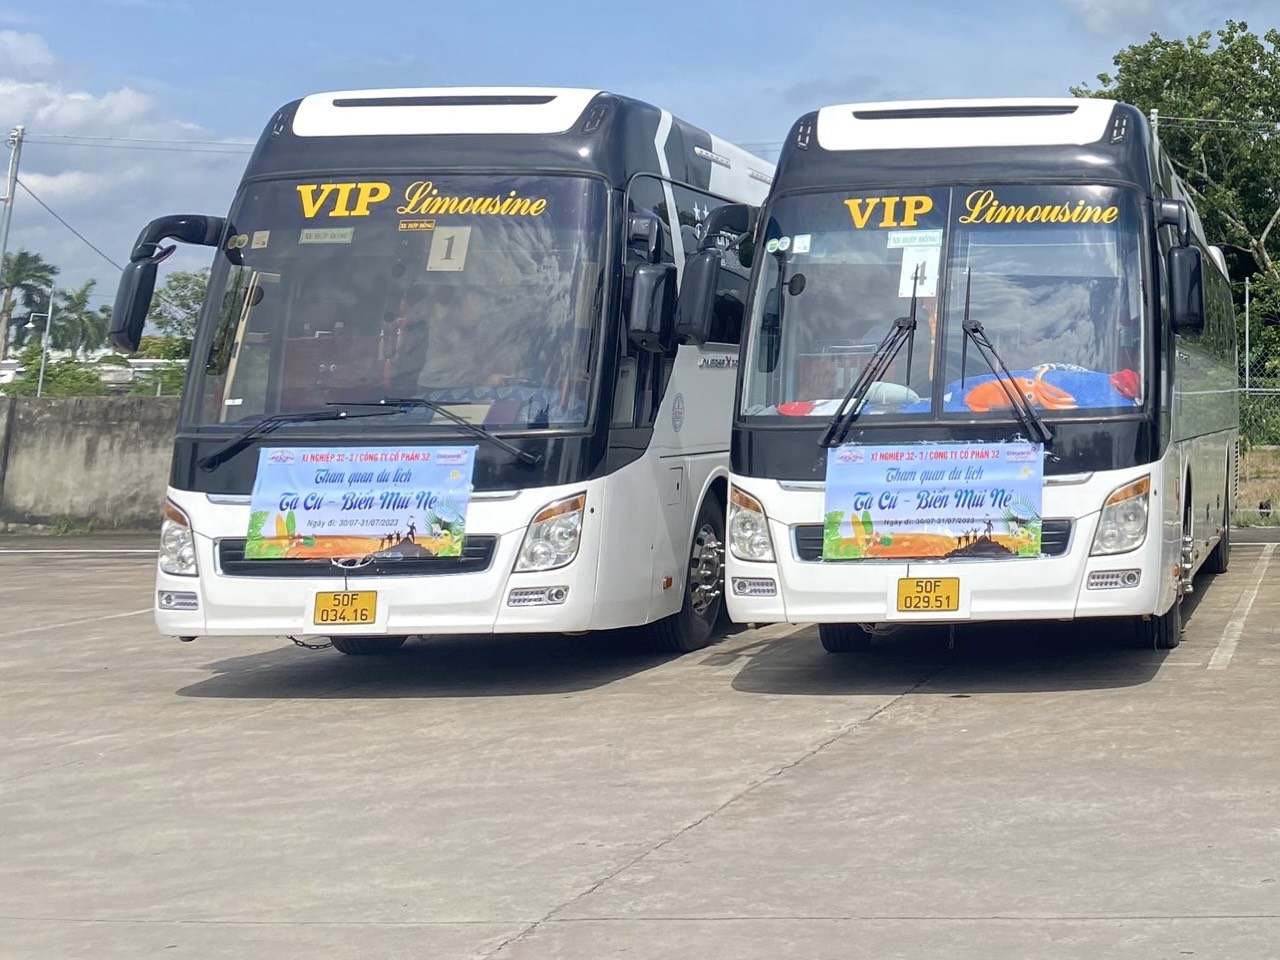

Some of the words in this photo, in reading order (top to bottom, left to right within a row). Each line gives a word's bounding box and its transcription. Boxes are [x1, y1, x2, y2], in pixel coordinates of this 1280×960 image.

[297, 182, 390, 218] VIP
[397, 181, 546, 216] Limousine
[844, 196, 933, 228] VIP
[959, 190, 1118, 224] Limousine
[441, 235, 456, 261] 1
[910, 261, 928, 286] 4
[380, 453, 388, 461] TY
[421, 453, 430, 461] 32
[950, 450, 957, 460] TY
[992, 450, 1000, 459] 32
[315, 469, 345, 484] Tham
[348, 472, 374, 487] quan
[376, 469, 390, 483] du
[393, 468, 412, 486] lịch
[886, 467, 916, 482] Tham
[920, 471, 945, 484] quan
[948, 466, 962, 480] du
[965, 465, 983, 483] lịch
[304, 492, 326, 510] Cú
[341, 489, 375, 510] Biển
[416, 491, 441, 510] Né
[878, 491, 900, 510] Cú
[916, 487, 950, 510] Biển
[990, 488, 1014, 509] Né
[307, 519, 326, 528] Ngày
[916, 580, 941, 593] 50F
[333, 594, 359, 606] 50F
[904, 595, 950, 609] 029.51
[321, 609, 368, 622] 034.16
